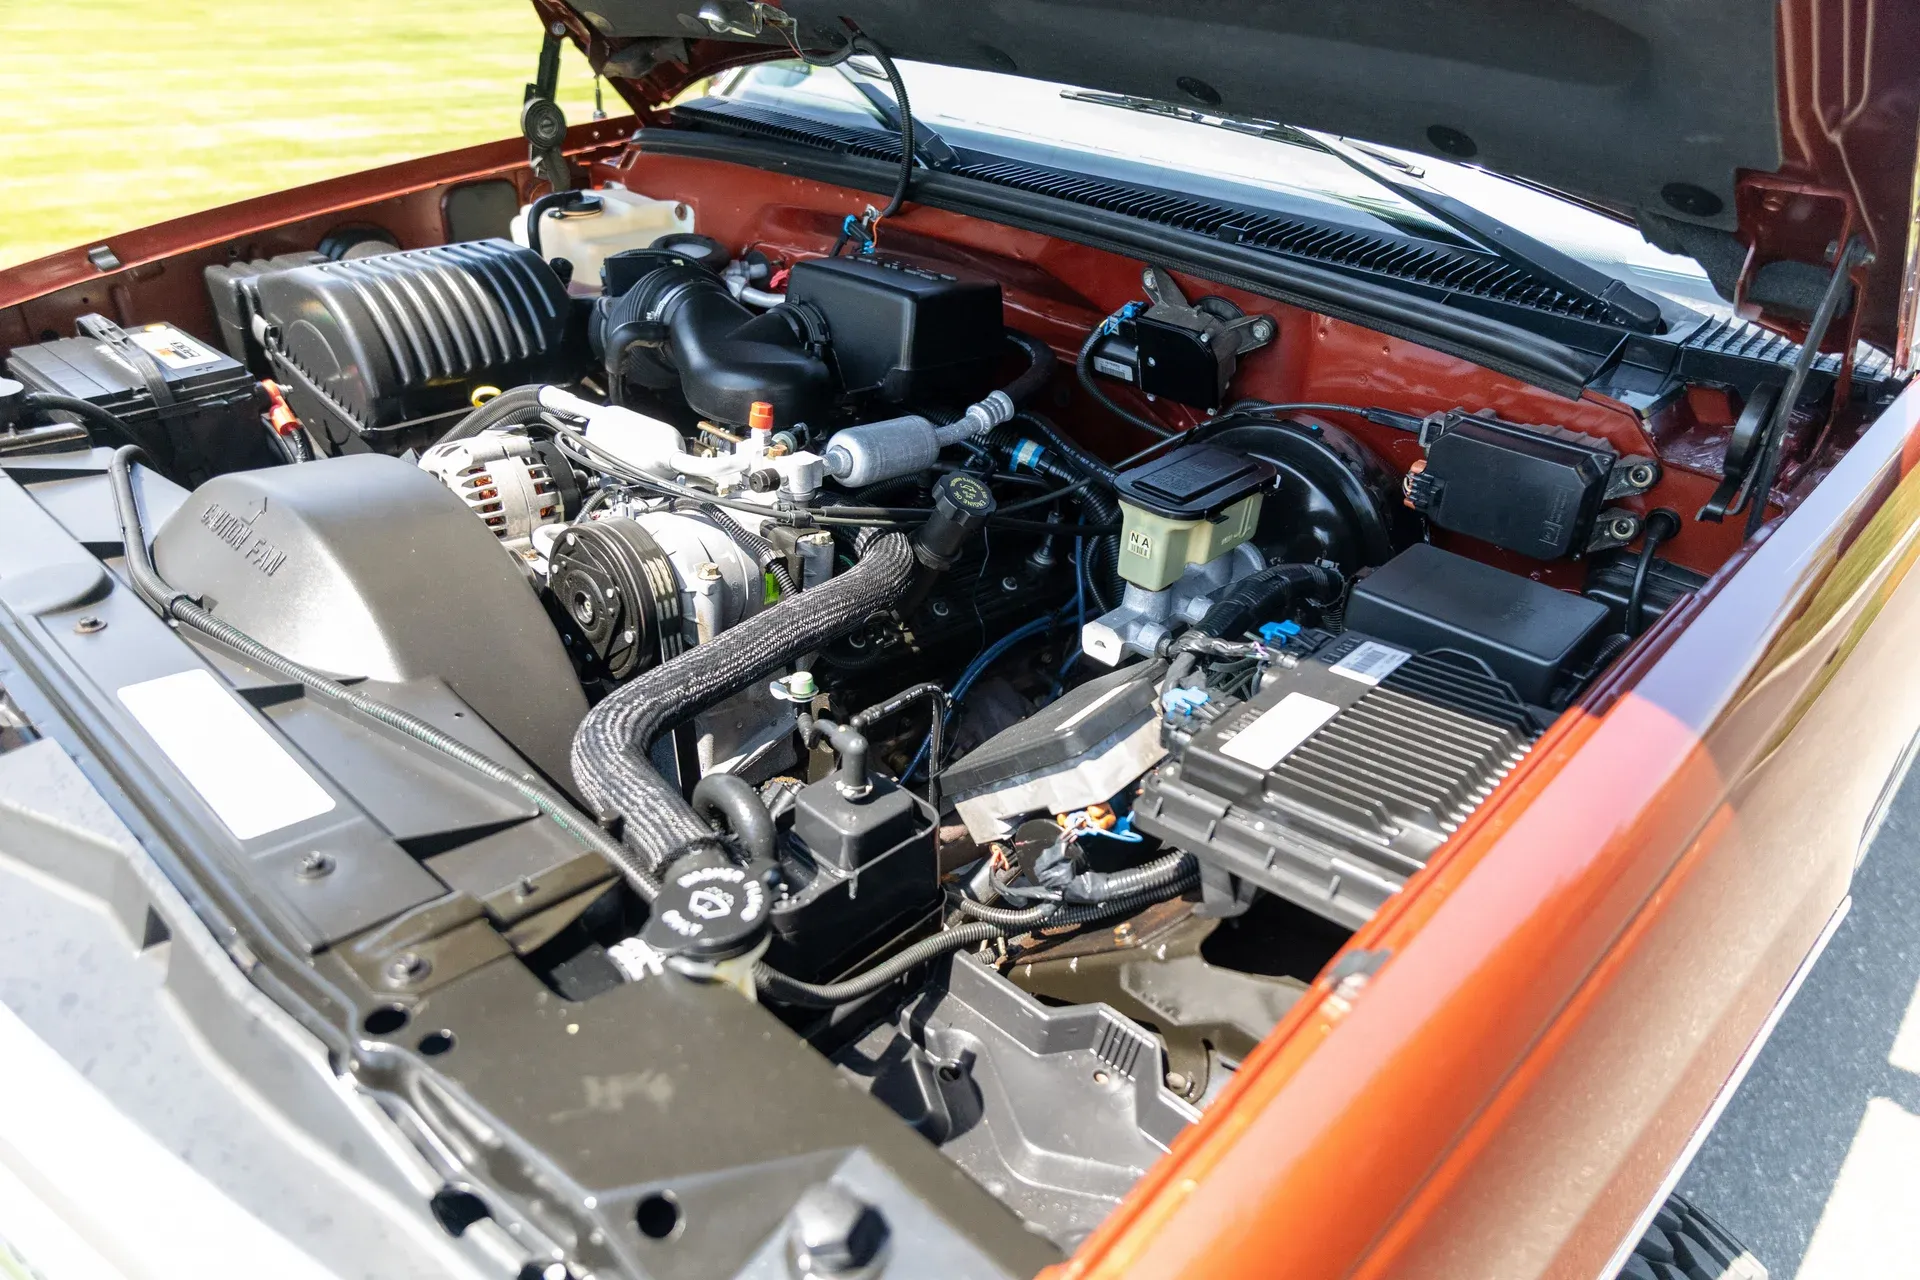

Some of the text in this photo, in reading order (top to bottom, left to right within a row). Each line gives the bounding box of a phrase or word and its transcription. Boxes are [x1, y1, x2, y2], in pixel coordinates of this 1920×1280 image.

[201, 503, 288, 577] CAUTION FAN
[661, 909, 704, 937] ONLY
